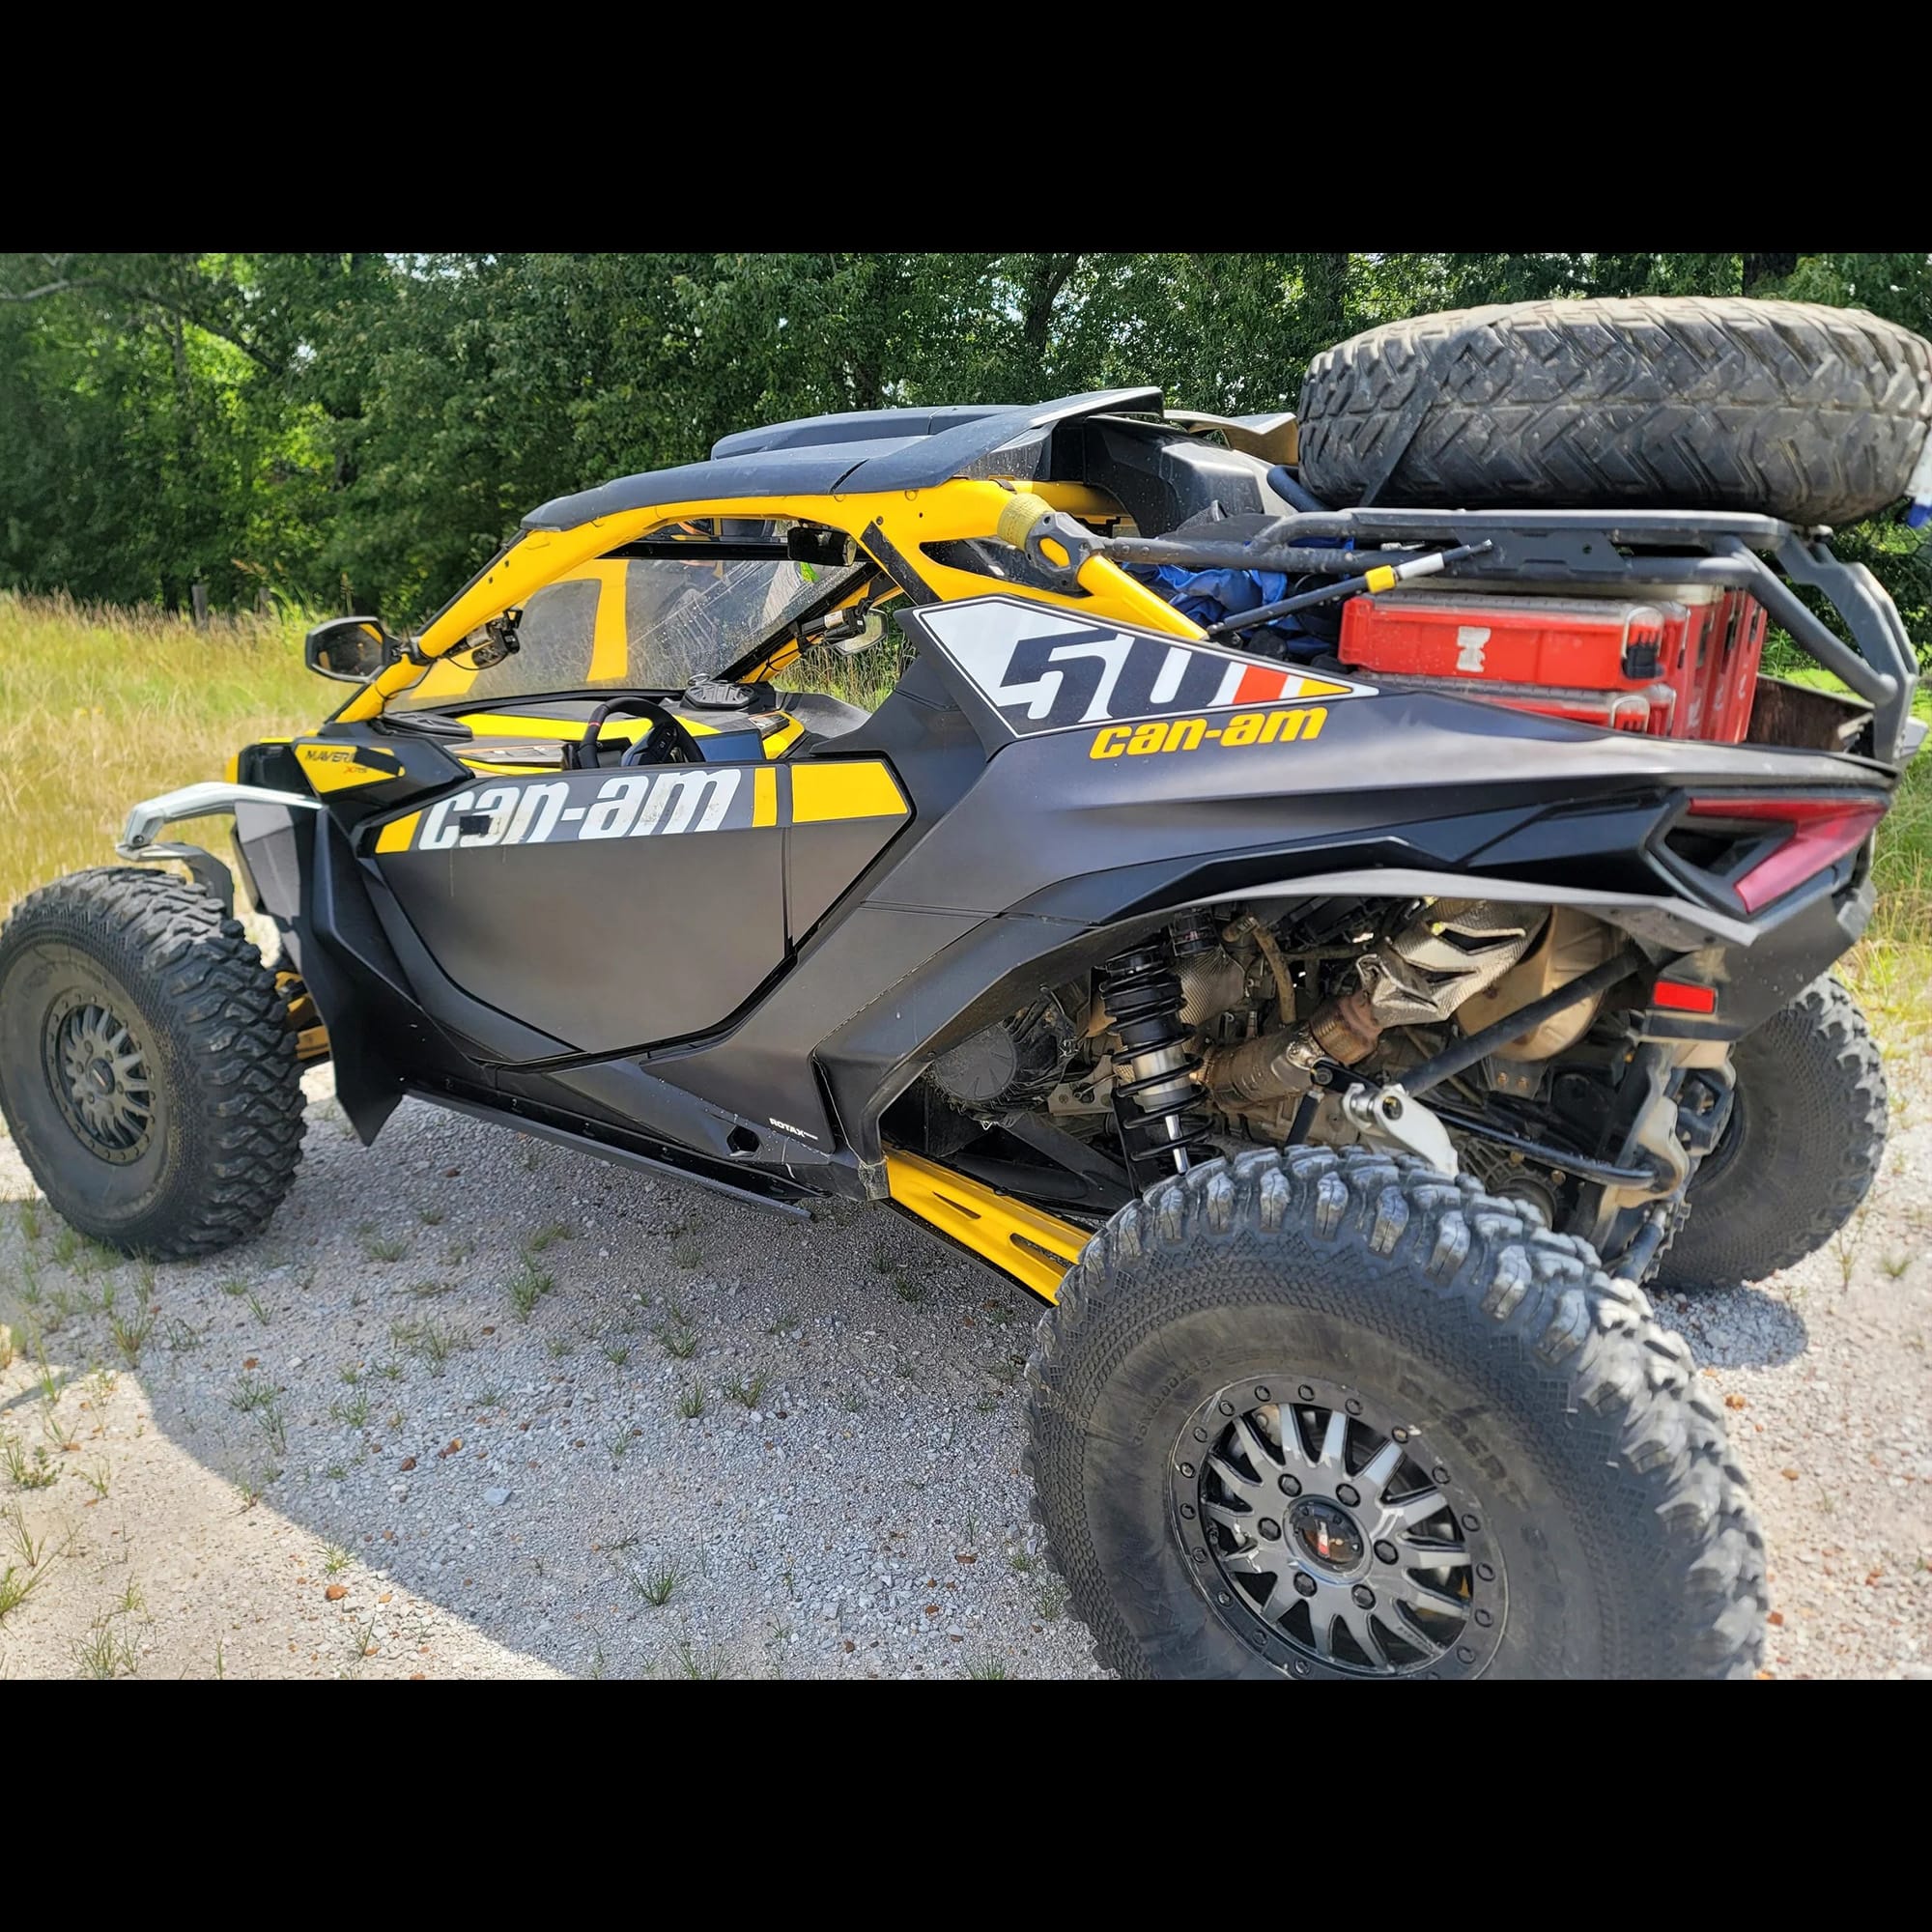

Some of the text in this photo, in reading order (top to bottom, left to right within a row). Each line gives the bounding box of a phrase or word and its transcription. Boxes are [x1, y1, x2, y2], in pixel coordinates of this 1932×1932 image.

[1089, 706, 1328, 760] can-am
[305, 750, 355, 763] MAVERI
[418, 769, 741, 850] can-am
[769, 1117, 806, 1138] ROTAX
